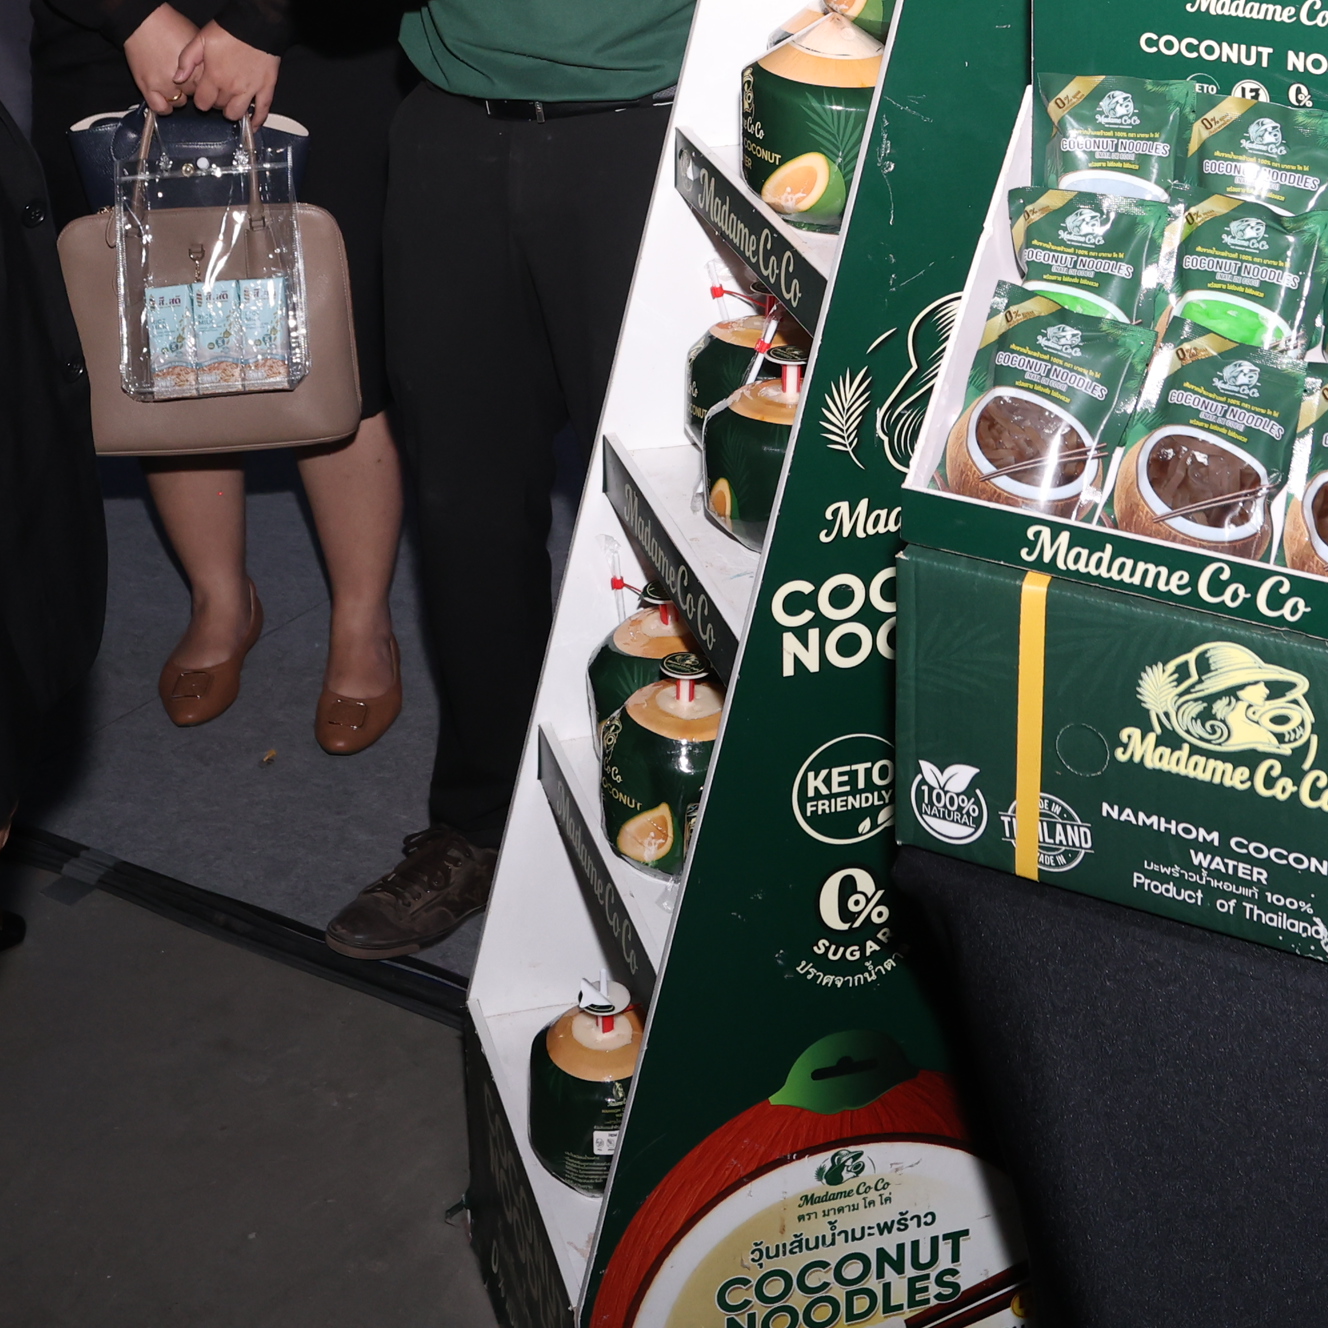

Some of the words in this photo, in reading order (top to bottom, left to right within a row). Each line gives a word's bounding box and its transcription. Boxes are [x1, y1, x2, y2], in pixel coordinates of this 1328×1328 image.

[1139, 33, 1273, 68] COCONUT
[1194, 83, 1217, 94] ETO
[1288, 83, 1314, 108] 0%
[1118, 138, 1171, 157] NOODLES
[698, 168, 758, 263] Madame
[759, 228, 779, 284] Co
[781, 250, 802, 308] Co
[1024, 248, 1077, 268] OCONUT
[1077, 255, 1134, 279] NOODLES
[1183, 254, 1241, 275] COCONUT
[1241, 262, 1301, 290] NOODLES
[995, 351, 1051, 376] COCONUT
[1050, 365, 1109, 401] NOODLES
[1168, 389, 1228, 416] COCONUT
[1227, 405, 1285, 441] NOODLES
[624, 483, 677, 594] Madame
[677, 564, 696, 621] Co
[697, 593, 716, 651] Co
[1020, 524, 1192, 596] Madame
[1197, 561, 1252, 609] Co
[1255, 575, 1312, 622] Co
[806, 759, 895, 798] KETO
[1114, 726, 1252, 791] Madame
[1252, 758, 1298, 802] Co
[601, 776, 643, 811] OCONUT
[805, 789, 893, 817] FRIENDLY
[920, 784, 980, 818] 100%
[921, 802, 977, 828] NATURAL
[1000, 814, 1093, 849] TILAND
[1101, 801, 1220, 847] NAMHOM
[1189, 848, 1269, 886] WATER
[819, 867, 890, 931] 0%
[1132, 871, 1204, 906] Product
[1216, 896, 1237, 915] of
[1242, 901, 1328, 940] Thailand
[1143, 859, 1260, 900] มะพร้าวน้ำหอมแท้
[1265, 890, 1314, 915] 100%
[813, 927, 893, 961] SUGAR
[796, 950, 905, 988] ปราศจากน้ำตา
[797, 1189, 854, 1209] Madame
[855, 1181, 873, 1195] Co
[874, 1177, 891, 1192] Co
[797, 1210, 818, 1223] ตรา
[822, 1203, 860, 1218] มาดาม
[862, 1196, 876, 1210] โค
[878, 1191, 893, 1205] โค่
[750, 1210, 937, 1270] วุ้นเส้นน้ำมะพร้าว
[715, 1228, 971, 1314] COCONUT
